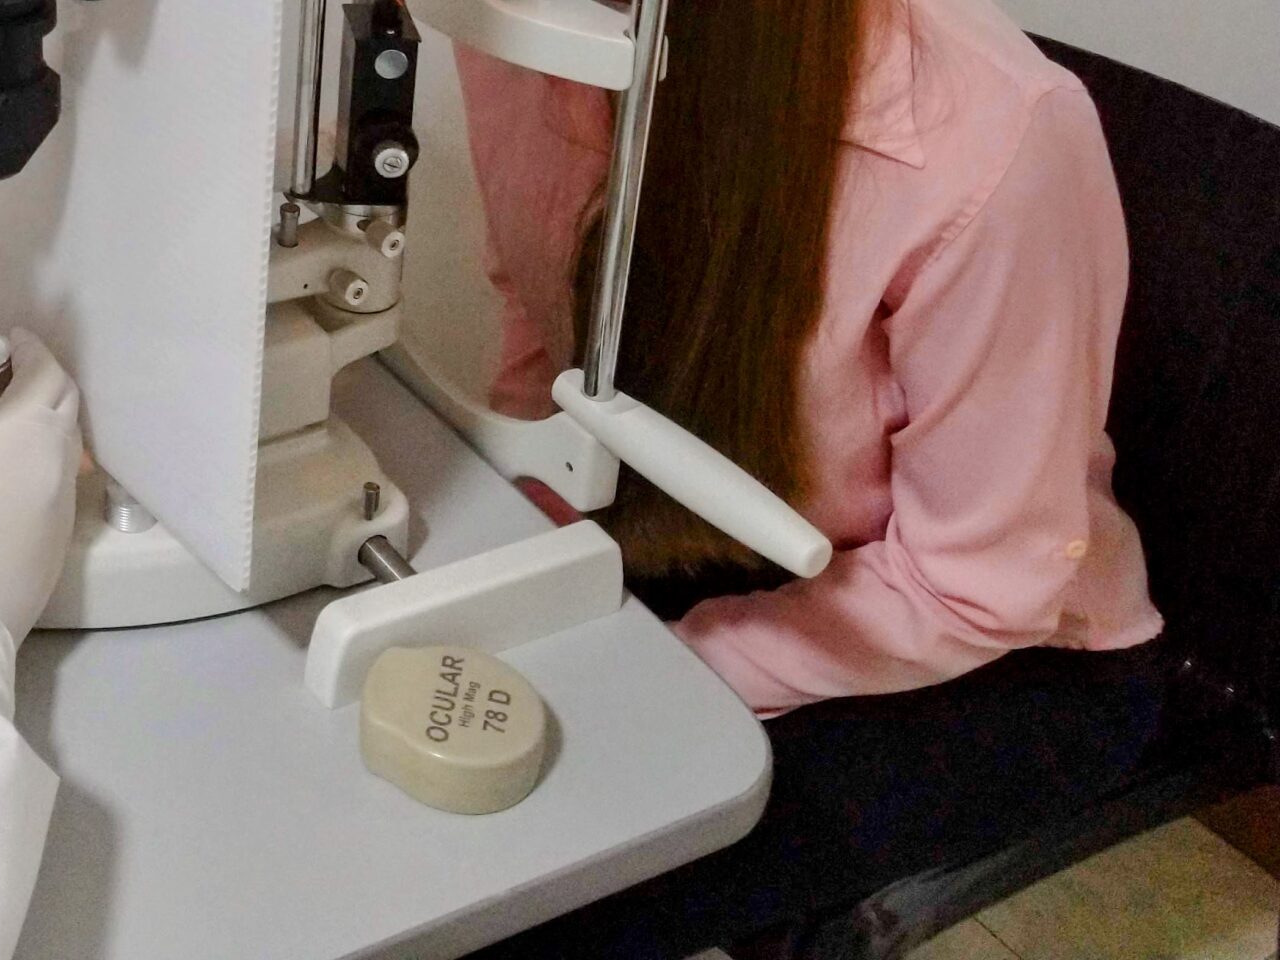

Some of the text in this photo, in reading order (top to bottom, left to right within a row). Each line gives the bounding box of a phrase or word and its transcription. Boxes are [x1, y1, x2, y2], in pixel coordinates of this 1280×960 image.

[425, 655, 465, 742] OCULAR
[458, 681, 481, 728] High Mag
[482, 689, 511, 734] 78 D
